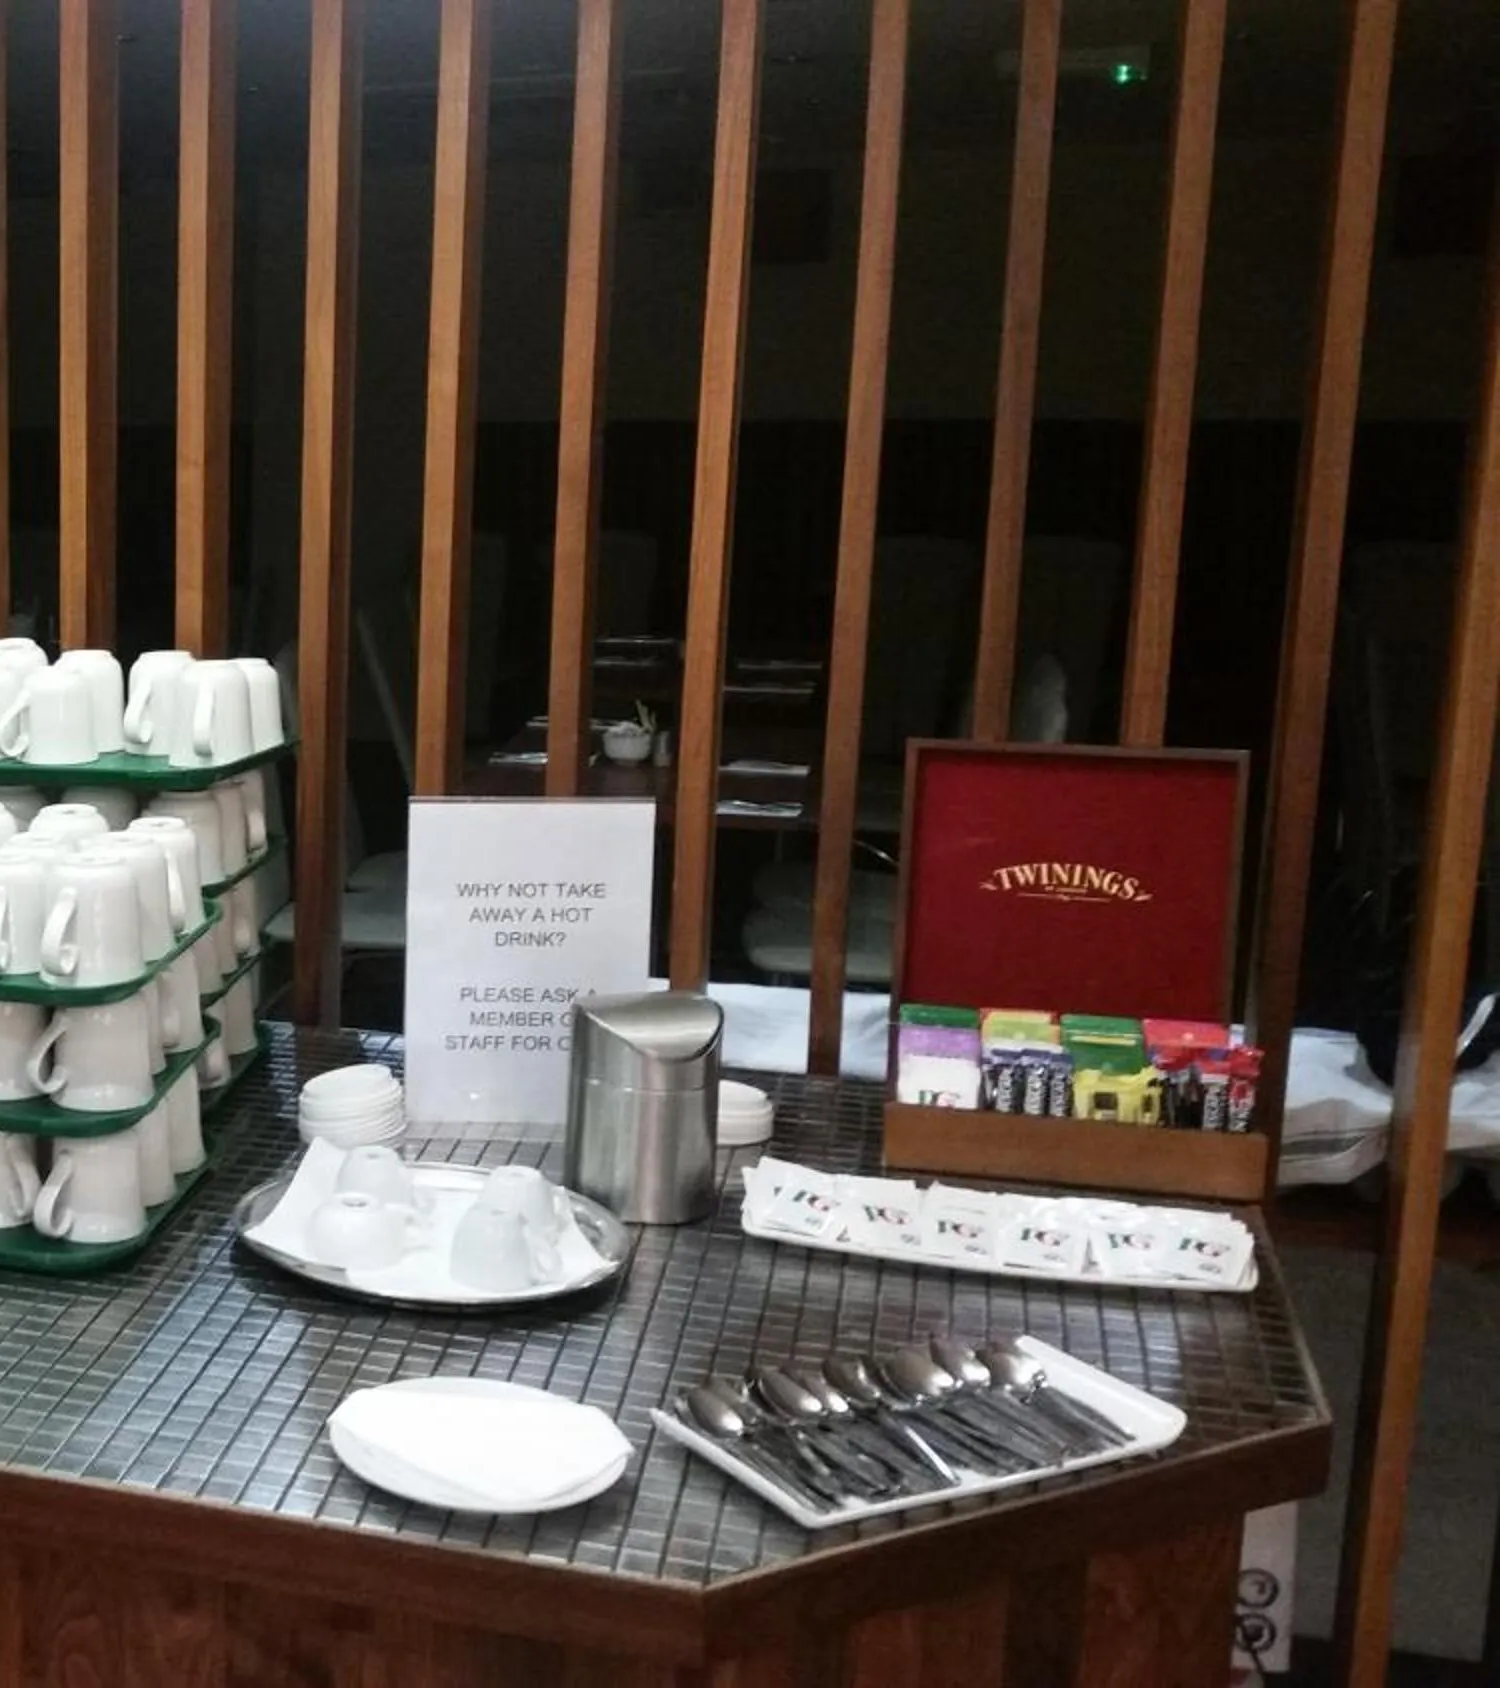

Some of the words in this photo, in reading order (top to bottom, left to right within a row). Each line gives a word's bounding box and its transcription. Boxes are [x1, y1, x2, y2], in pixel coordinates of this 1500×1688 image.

[456, 881, 504, 898] WHY
[507, 881, 549, 898] NOT
[554, 881, 606, 898] TAKE
[993, 862, 1140, 900] TWININGS
[468, 906, 527, 923] AWAY
[531, 906, 545, 923] A
[550, 906, 594, 923] HOT
[494, 930, 567, 947] DRINK?
[460, 986, 535, 1003] PLEASE
[540, 986, 579, 1003] ASK
[469, 1011, 554, 1028] MEMBER
[445, 1034, 505, 1051] STAFF
[510, 1034, 551, 1051] FOR
